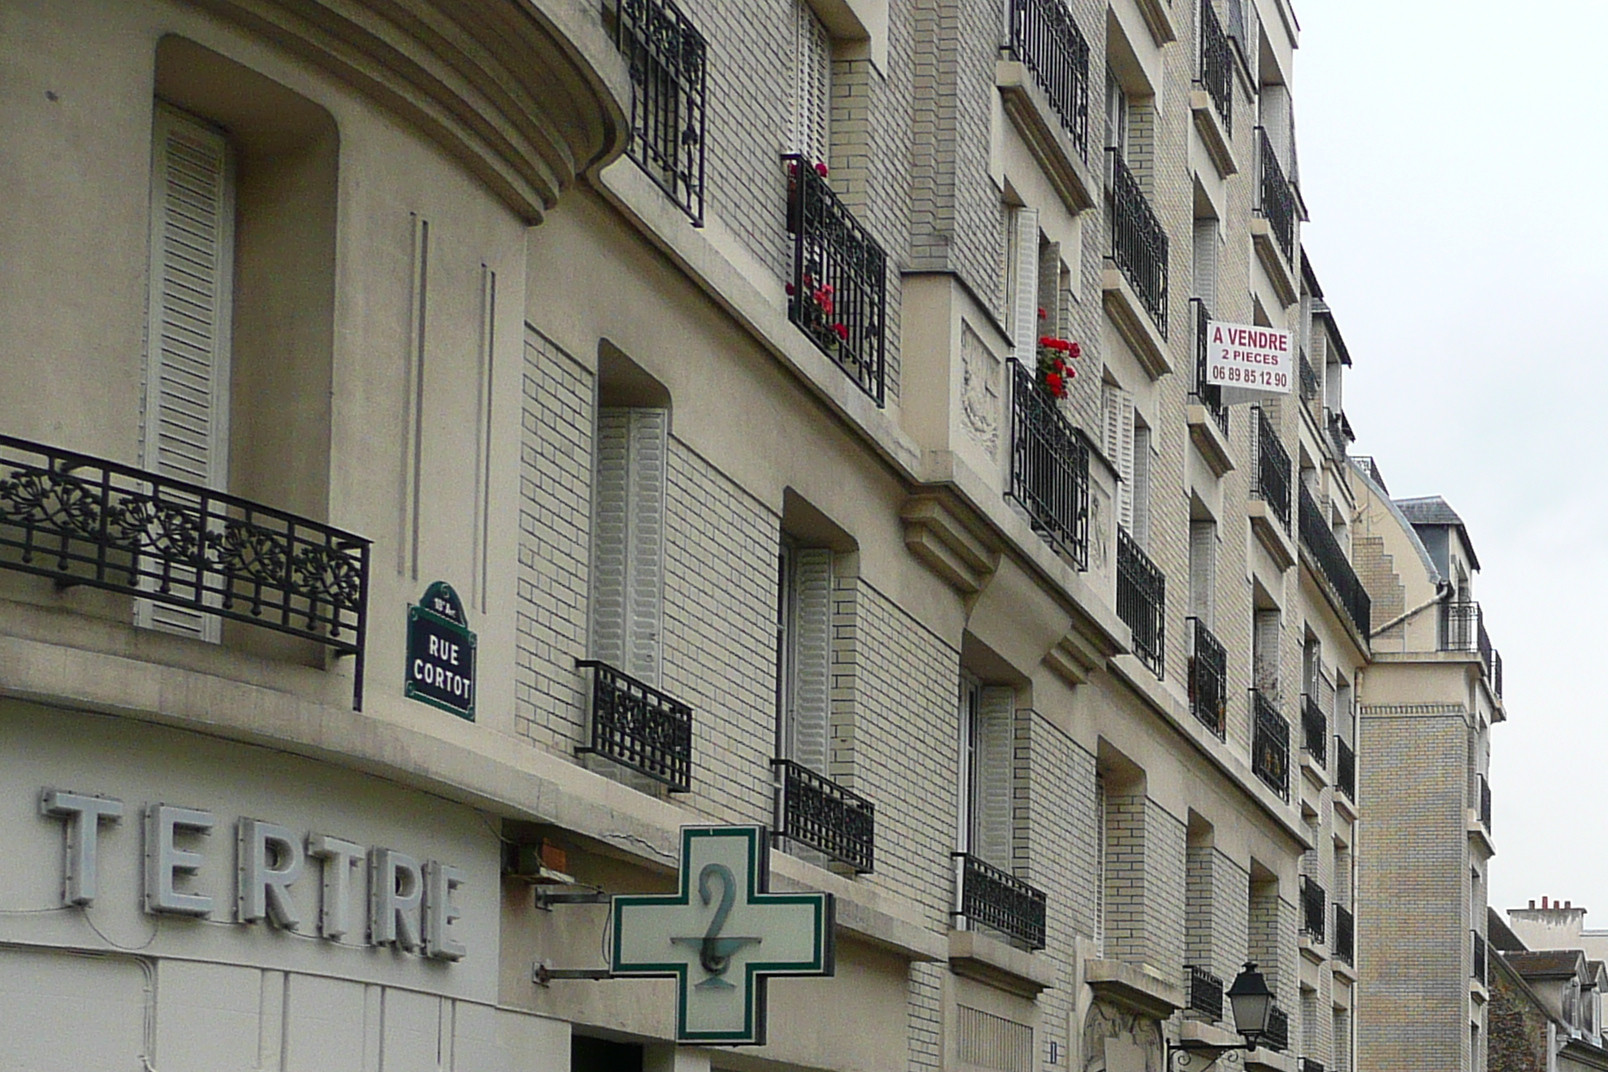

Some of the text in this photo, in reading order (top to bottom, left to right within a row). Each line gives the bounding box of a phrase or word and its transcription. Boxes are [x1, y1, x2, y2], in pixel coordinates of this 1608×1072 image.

[1213, 326, 1288, 352] A VENDRE
[1221, 348, 1279, 366] 2 PIECES
[1212, 365, 1288, 388] 06 89 85 12 90
[429, 634, 460, 666] RUE
[414, 658, 471, 699] CORTOT
[40, 786, 467, 963] TERTRE
